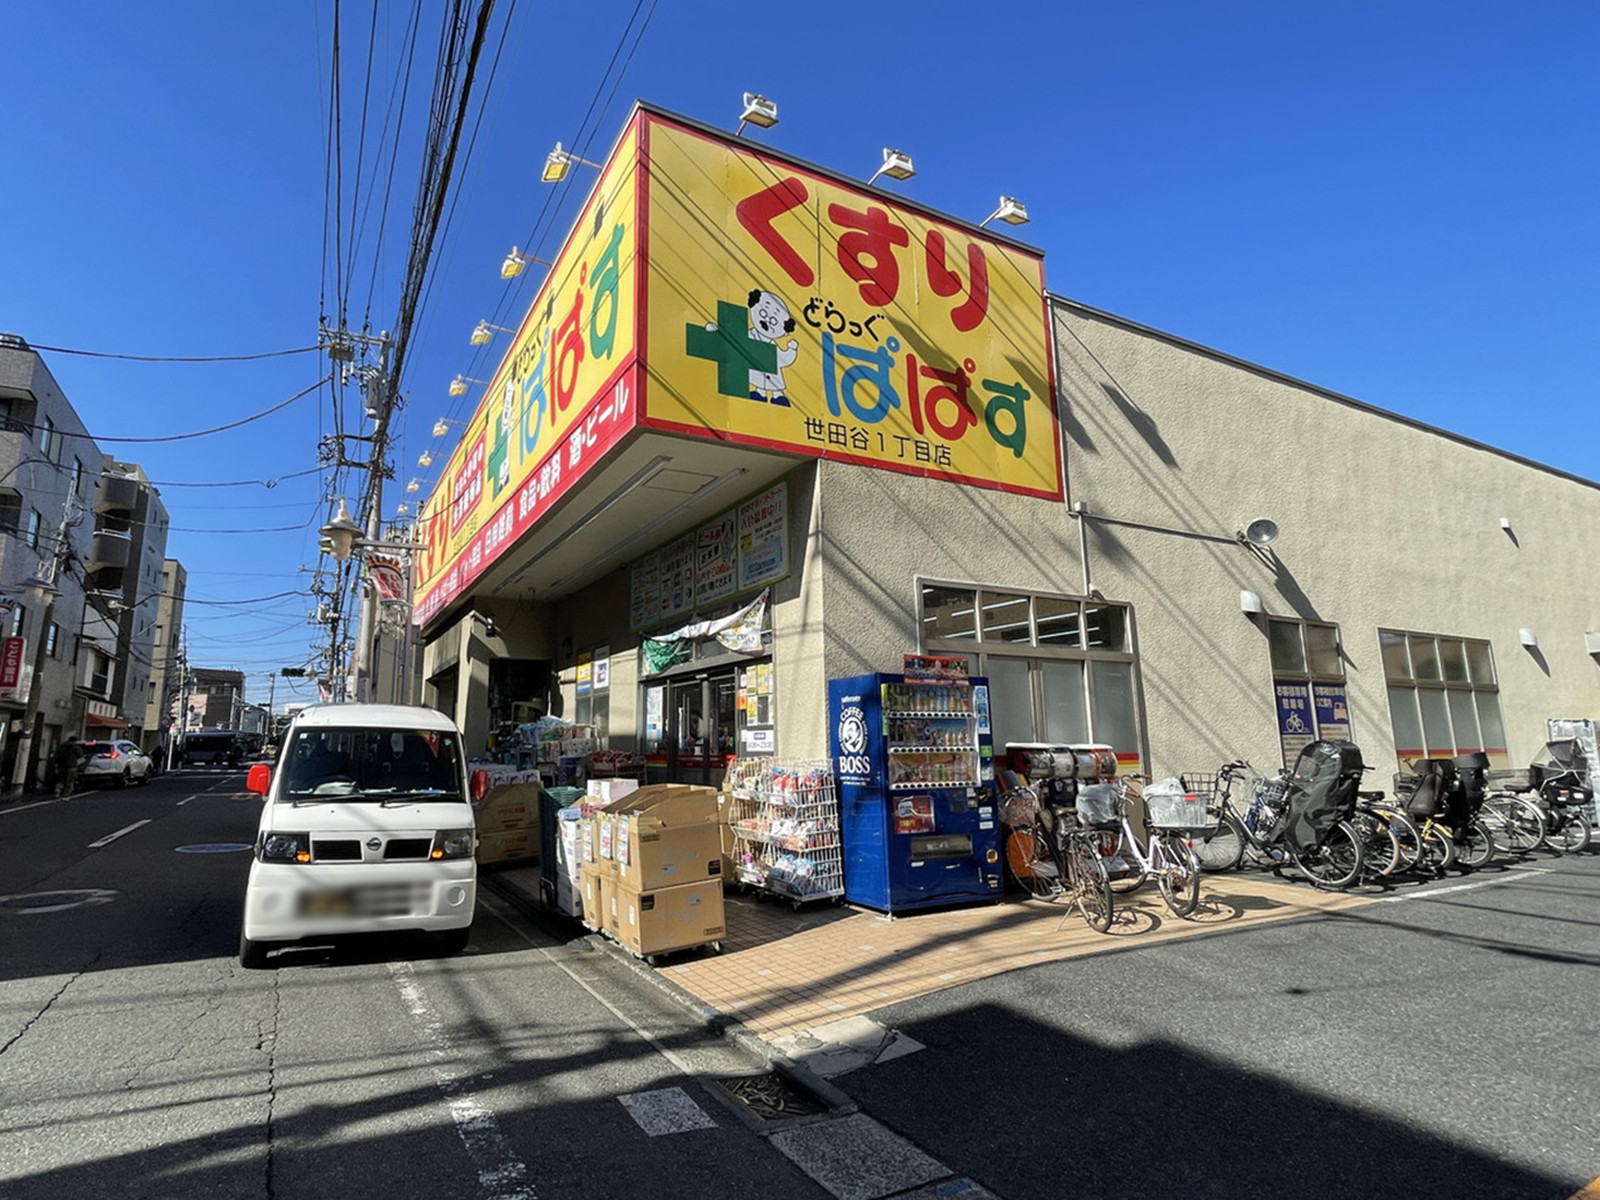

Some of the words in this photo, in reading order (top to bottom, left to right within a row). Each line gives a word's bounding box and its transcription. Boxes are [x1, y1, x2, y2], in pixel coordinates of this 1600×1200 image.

[736, 177, 989, 332] くすり
[519, 222, 625, 466] ぱぱす
[803, 297, 885, 342] どらっぐ
[568, 378, 630, 469] 酒・ビール
[821, 331, 1031, 459] ぱぱす
[804, 418, 952, 466] 世田谷1丁目店
[840, 706, 865, 721] COFFEE
[839, 756, 870, 774] BOSS
